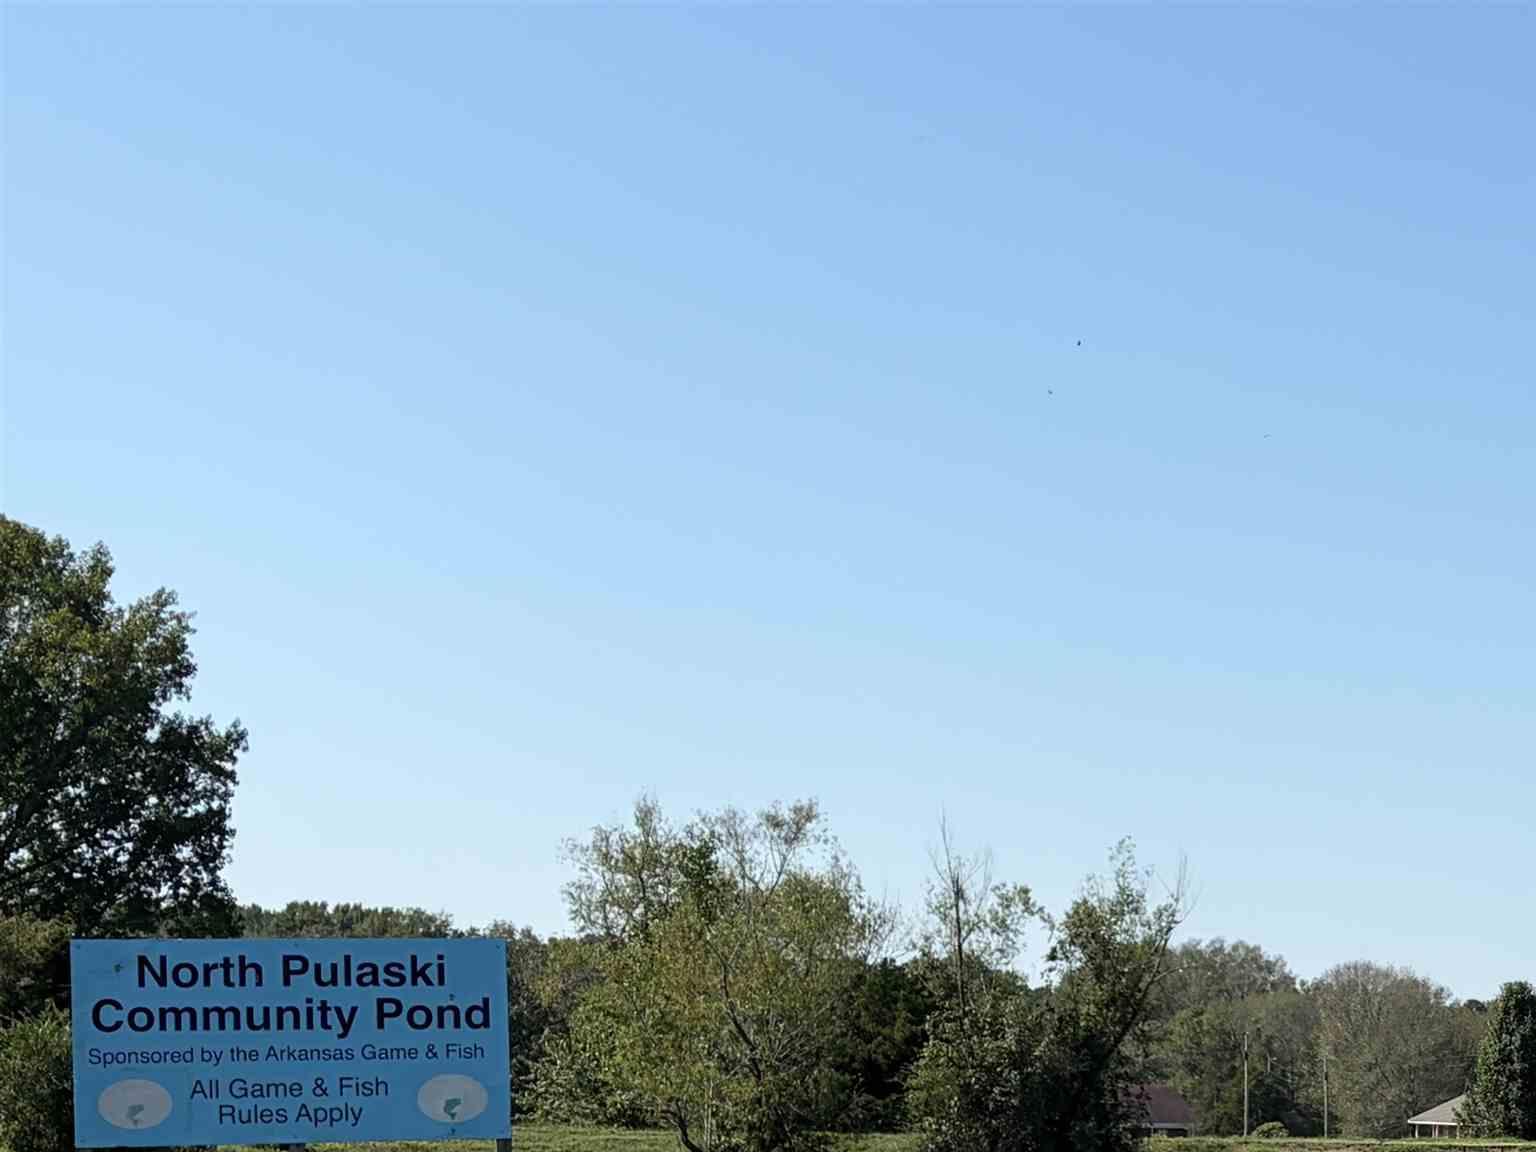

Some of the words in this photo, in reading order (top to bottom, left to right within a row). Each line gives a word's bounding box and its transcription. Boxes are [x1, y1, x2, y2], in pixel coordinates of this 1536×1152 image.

[137, 954, 263, 988] North
[282, 954, 446, 988] Pulaski
[91, 998, 358, 1038] Community
[376, 997, 491, 1031] Pond
[88, 1047, 194, 1069] Sponsored
[201, 1046, 224, 1067] by
[230, 1046, 259, 1062] the
[265, 1045, 354, 1062] Arkansas
[361, 1045, 419, 1061] Game
[425, 1044, 438, 1060] &
[446, 1043, 485, 1060] Fish
[190, 1079, 220, 1100] All
[228, 1078, 303, 1098] Game
[312, 1078, 329, 1097] &
[339, 1076, 389, 1097] Fish
[218, 1104, 288, 1125] Rules
[294, 1102, 363, 1128] Apply
